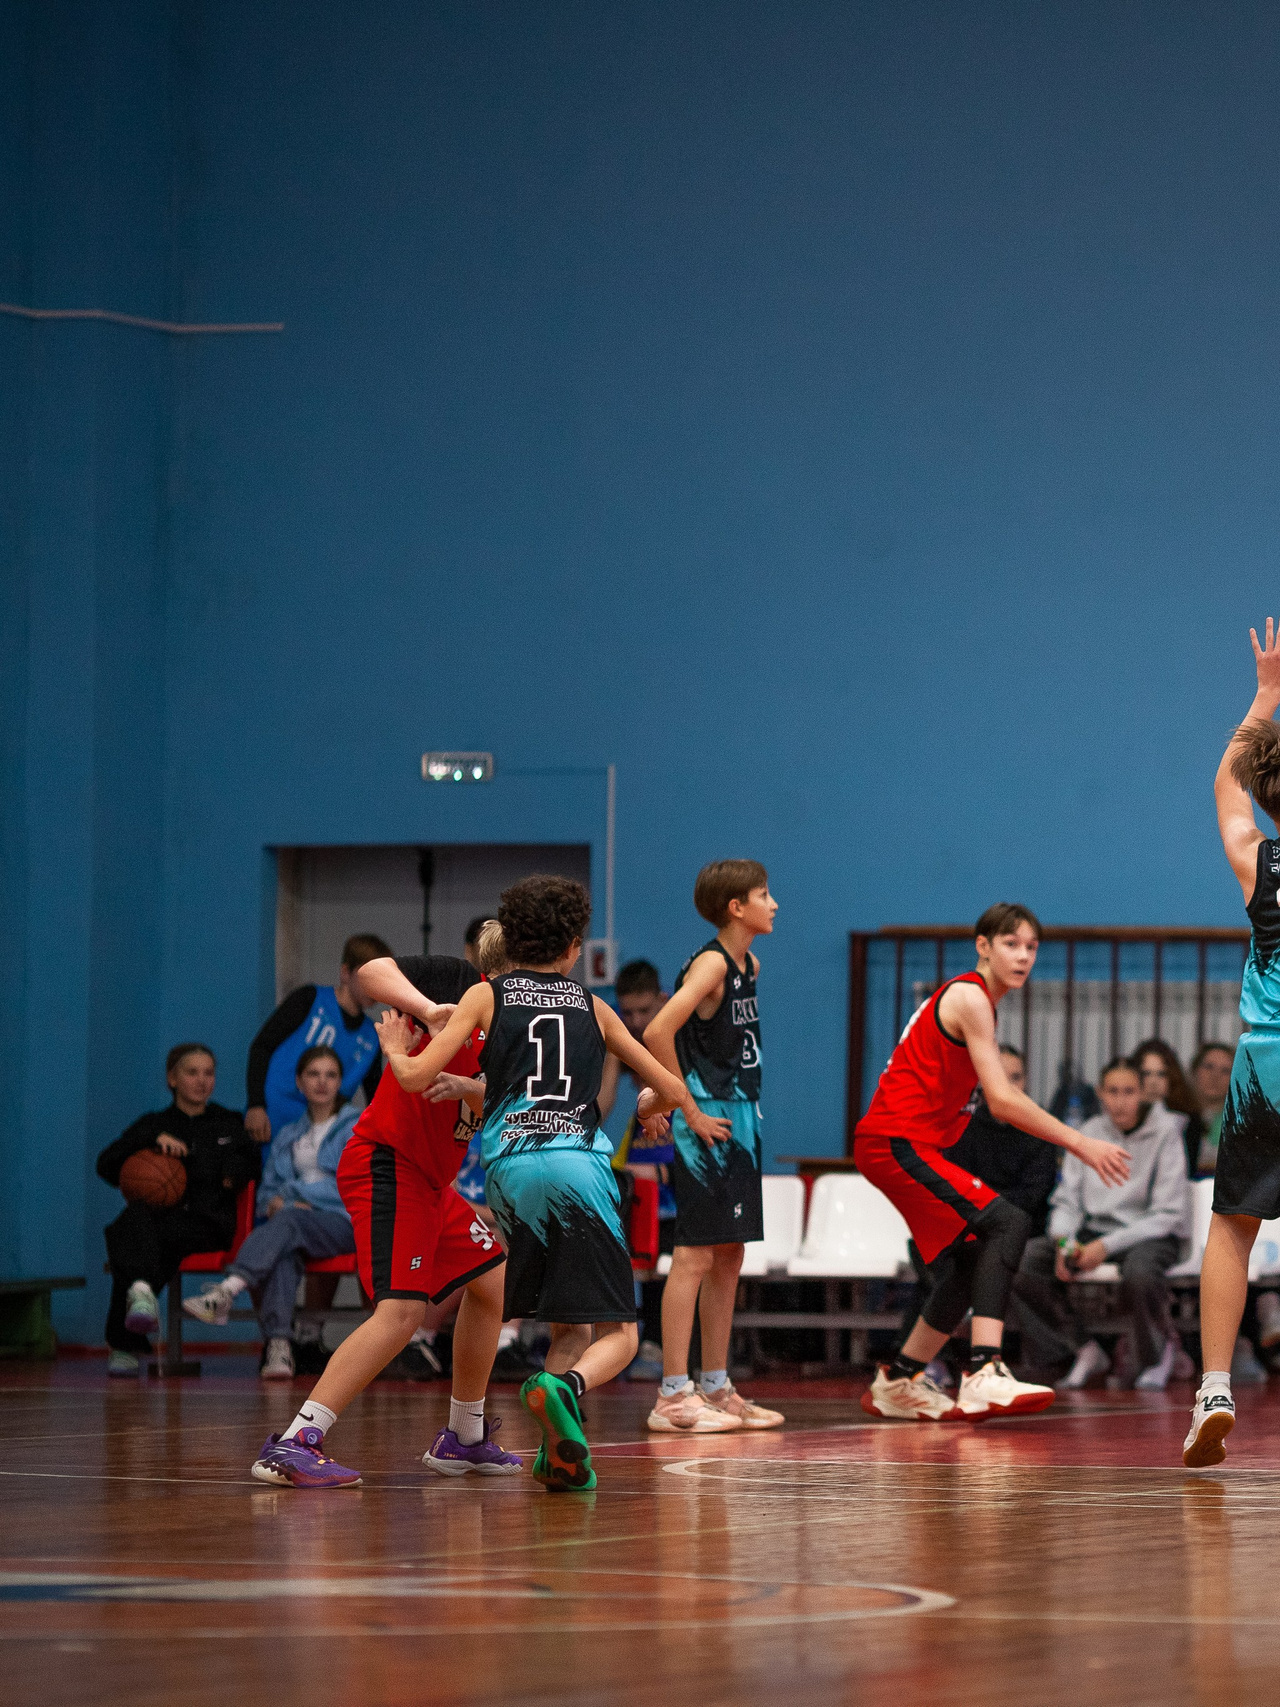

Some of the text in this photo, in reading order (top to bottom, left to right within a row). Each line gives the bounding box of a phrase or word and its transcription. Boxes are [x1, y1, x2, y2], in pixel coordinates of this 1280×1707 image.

[503, 990, 589, 1012] БАСКЕТБОЛА
[527, 1014, 571, 1101] 1
[504, 1104, 587, 1125] ЧУВАШСОЙ
